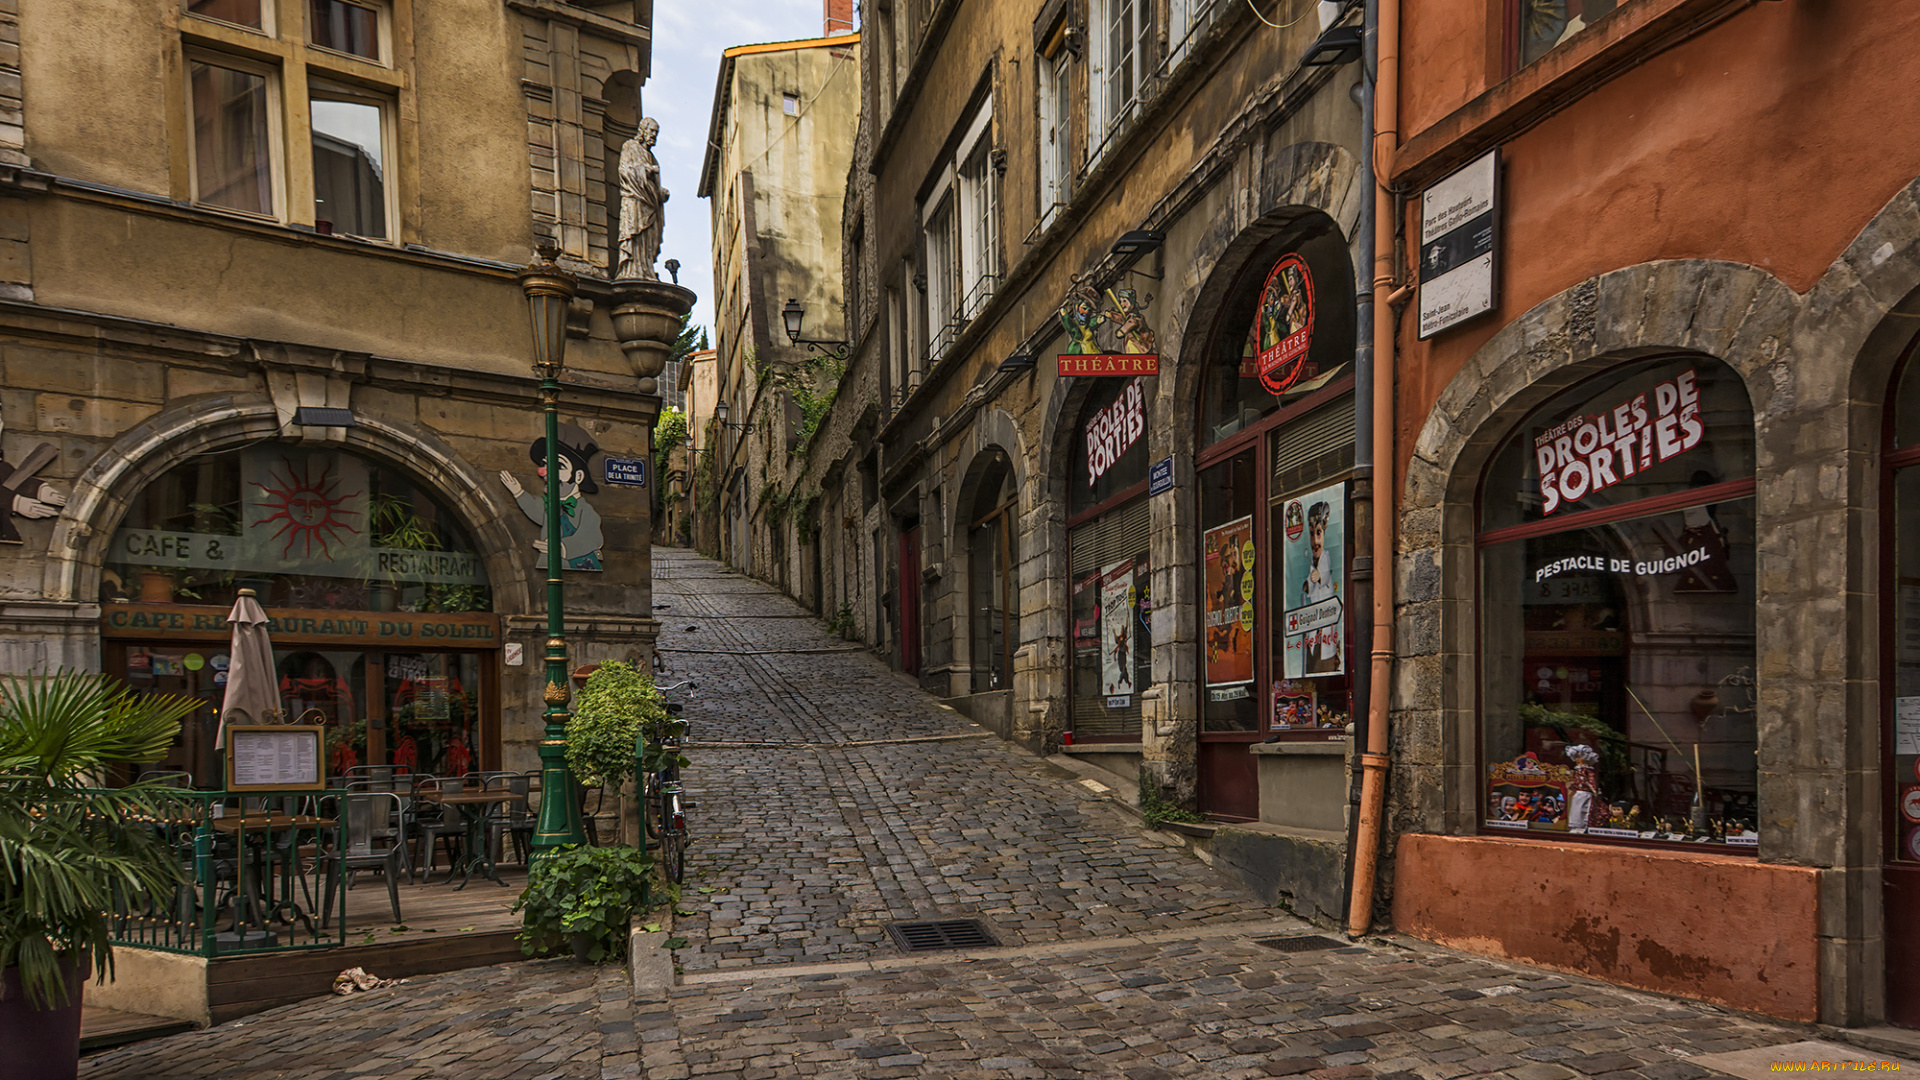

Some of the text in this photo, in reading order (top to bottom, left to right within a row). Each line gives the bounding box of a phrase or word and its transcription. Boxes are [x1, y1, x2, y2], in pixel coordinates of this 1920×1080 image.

[1438, 210, 1448, 222] des
[1422, 304, 1450, 321] Saint-Jean
[1262, 331, 1307, 365] THÉÂTRE
[1060, 356, 1157, 372] THÉÂTRE
[1126, 377, 1142, 411] DE
[1654, 369, 1699, 417] DE
[1534, 415, 1584, 447] THÉÂTRE DES
[613, 464, 637, 472] PLACE
[126, 532, 224, 560] CAFE &
[378, 552, 479, 577] RESTAURANT
[1535, 546, 1711, 583] PESTACLE DE GUIGNOL
[190, 613, 369, 637] REAURANT
[377, 620, 413, 639] DU
[420, 622, 495, 640] SOLEIL
[1299, 606, 1337, 626] Guignol Dentiste
[1287, 640, 1302, 650] Le
